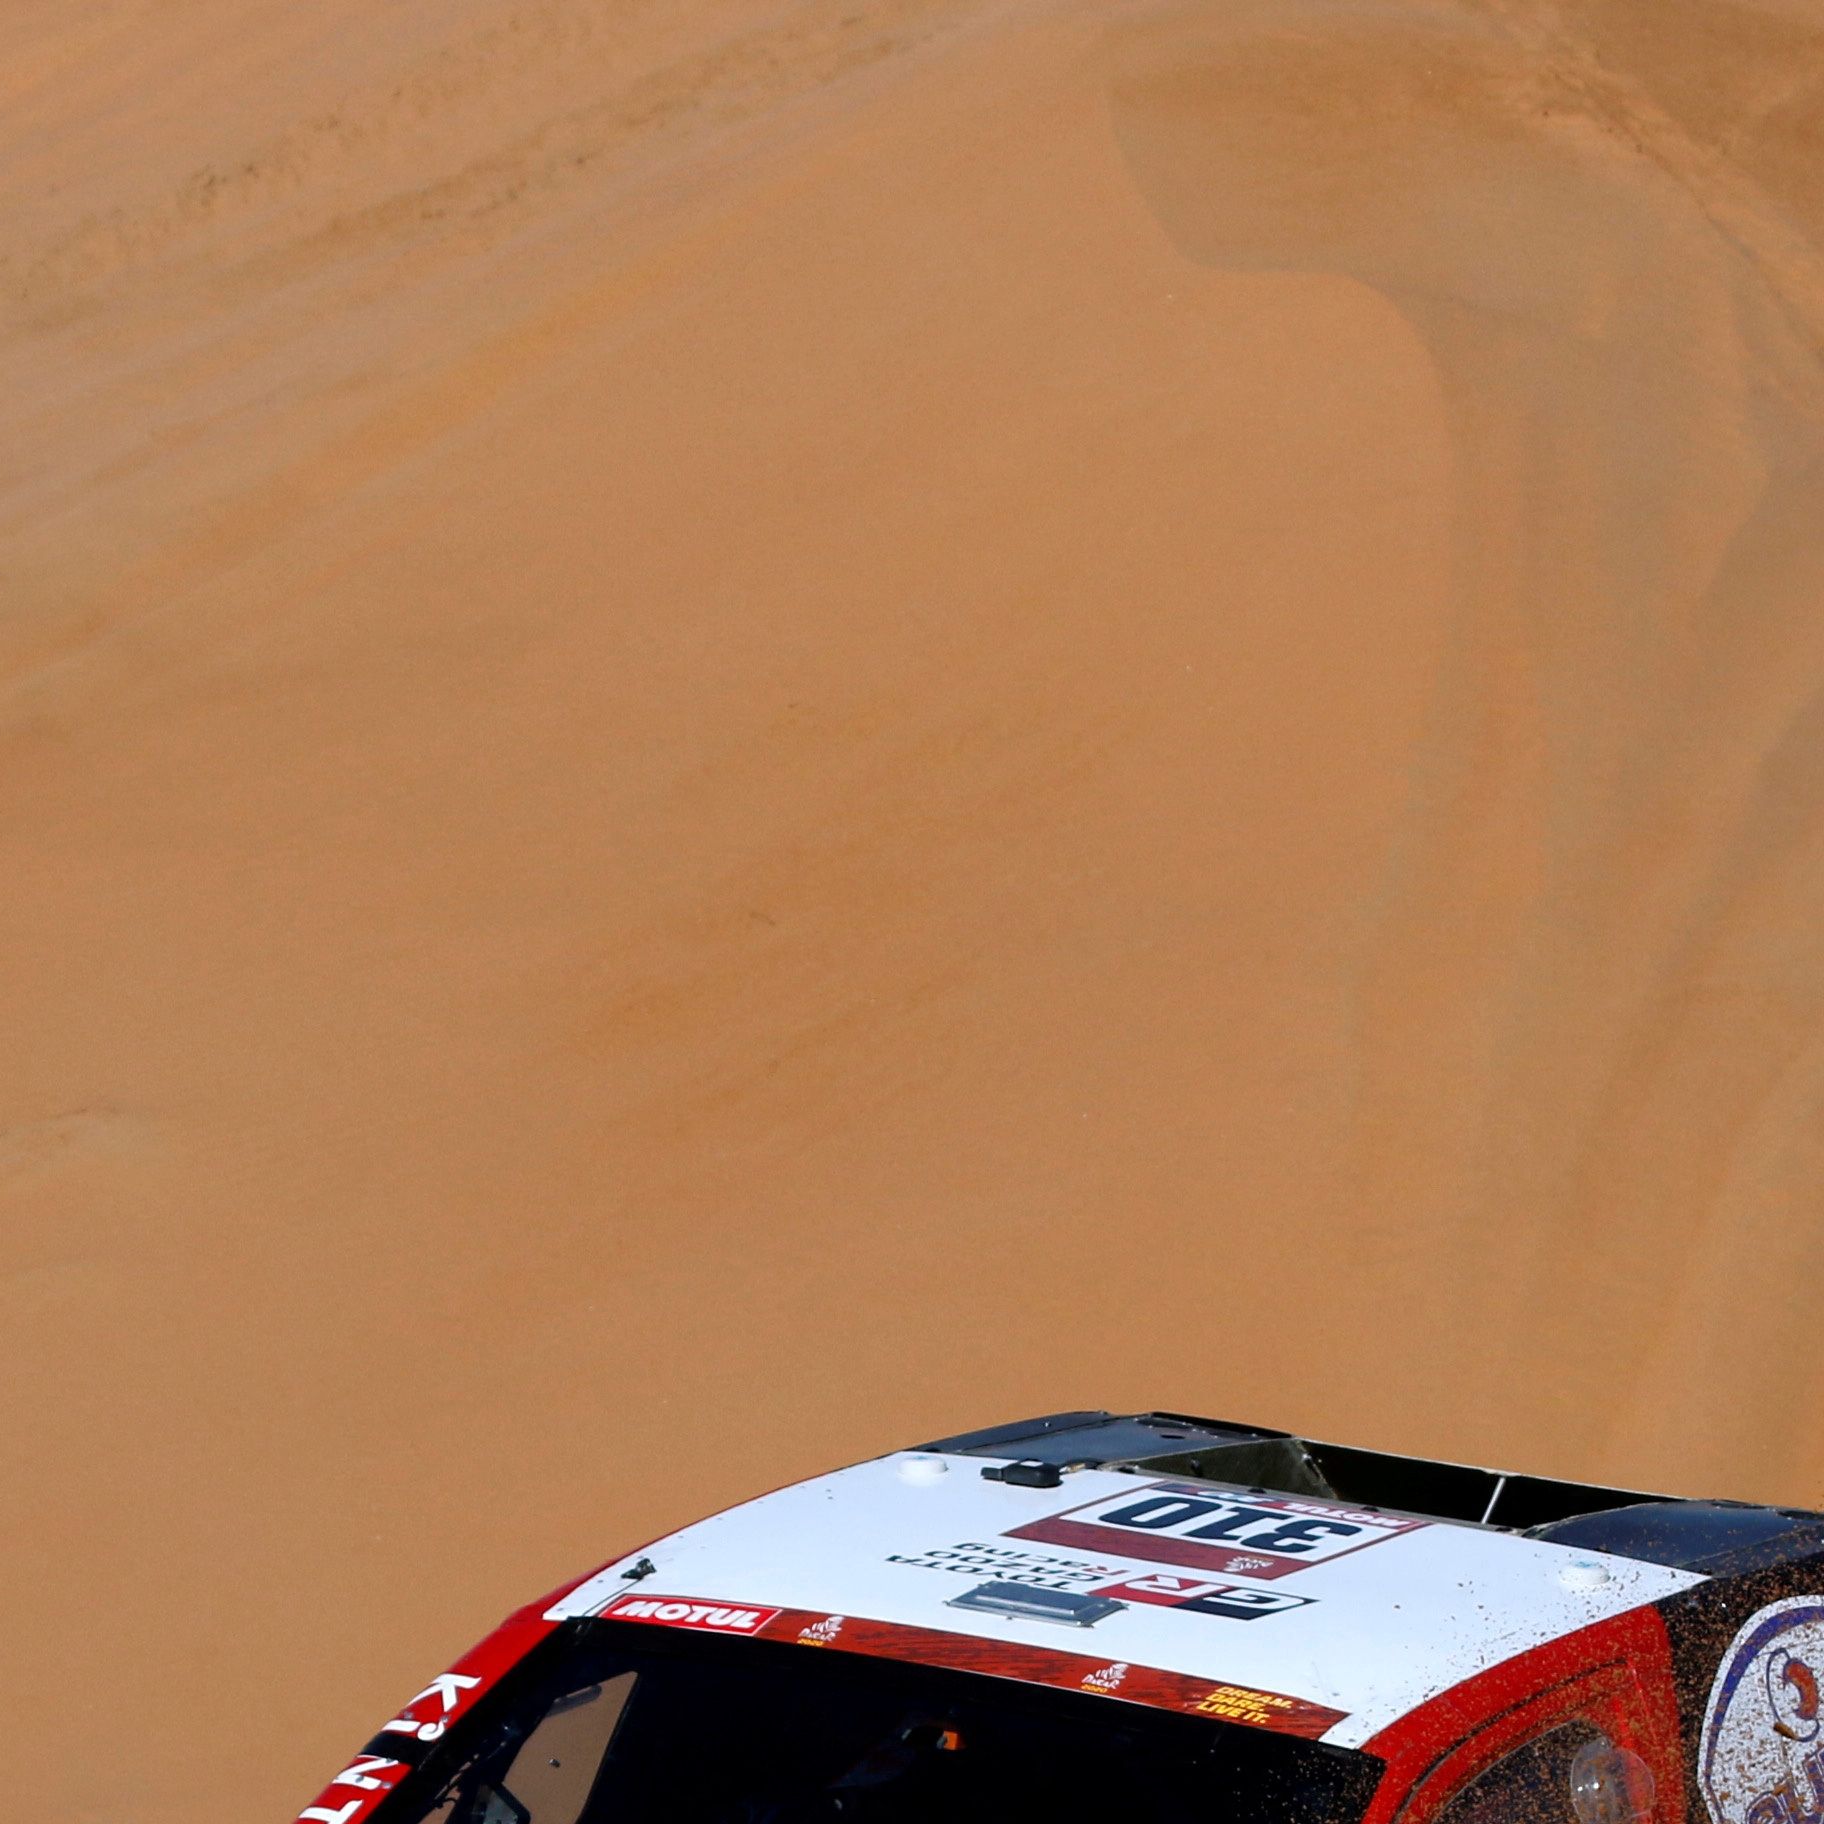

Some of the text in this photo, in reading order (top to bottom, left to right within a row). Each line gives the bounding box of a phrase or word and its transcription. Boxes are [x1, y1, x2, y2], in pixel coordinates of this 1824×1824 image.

[1098, 1496, 1363, 1553] 310
[1283, 1503, 1411, 1526] MOTUL
[884, 1555, 1073, 1590] TOYOTA
[924, 1550, 1105, 1581] GAZOO
[952, 1542, 1130, 1576] Racing
[1125, 1574, 1304, 1611] GR
[612, 1601, 761, 1629] MOTUL
[1205, 1692, 1265, 1712] DARE.
[1215, 1686, 1293, 1709] DREAM.
[1196, 1702, 1271, 1724] LIVE IT.
